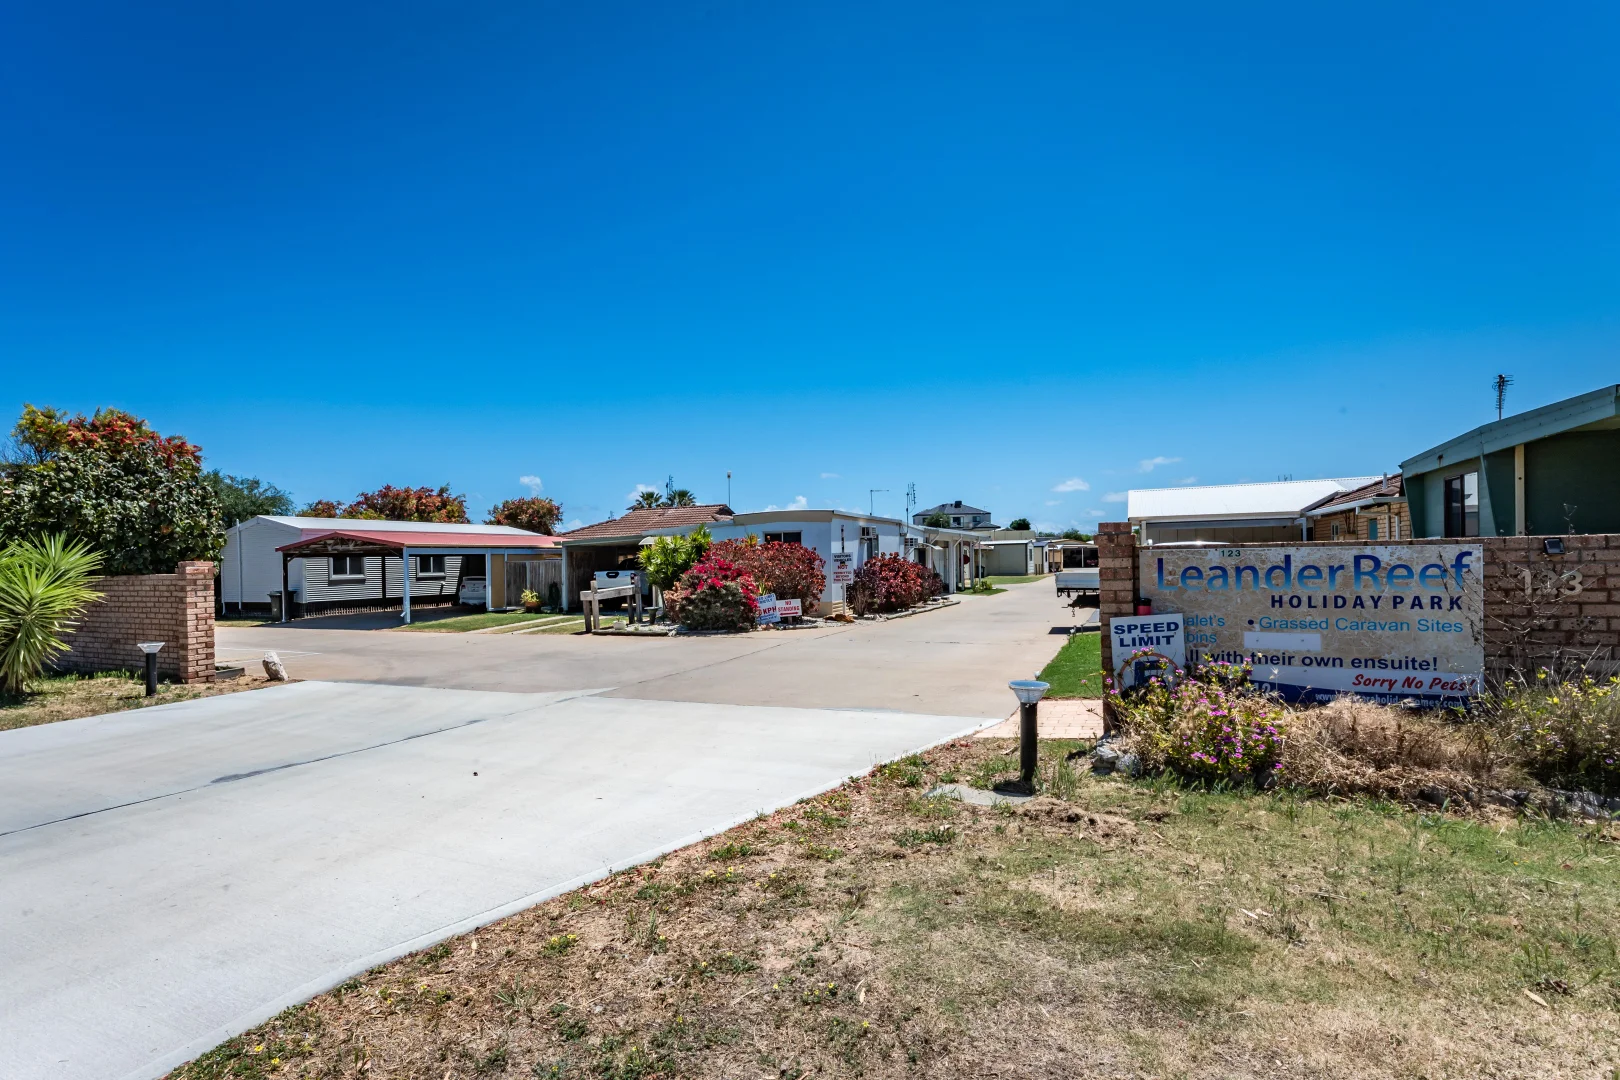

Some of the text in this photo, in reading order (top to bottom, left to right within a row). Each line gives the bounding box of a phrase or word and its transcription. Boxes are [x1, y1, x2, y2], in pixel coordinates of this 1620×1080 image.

[1156, 551, 1473, 592] Leander Reef
[1517, 570, 1583, 595] 123
[1271, 594, 1463, 611] HOLIDAY PARK
[1113, 621, 1180, 635] SPEED
[1183, 614, 1464, 633] alet's Grassed Caravan Sites
[1119, 635, 1175, 648] LIMIT
[1184, 630, 1218, 643] bins
[1205, 650, 1244, 664] with
[1250, 651, 1295, 666] their
[1301, 656, 1344, 668] own
[1351, 656, 1438, 671] ensuite!
[1352, 674, 1476, 692] Sorry No Pets!
